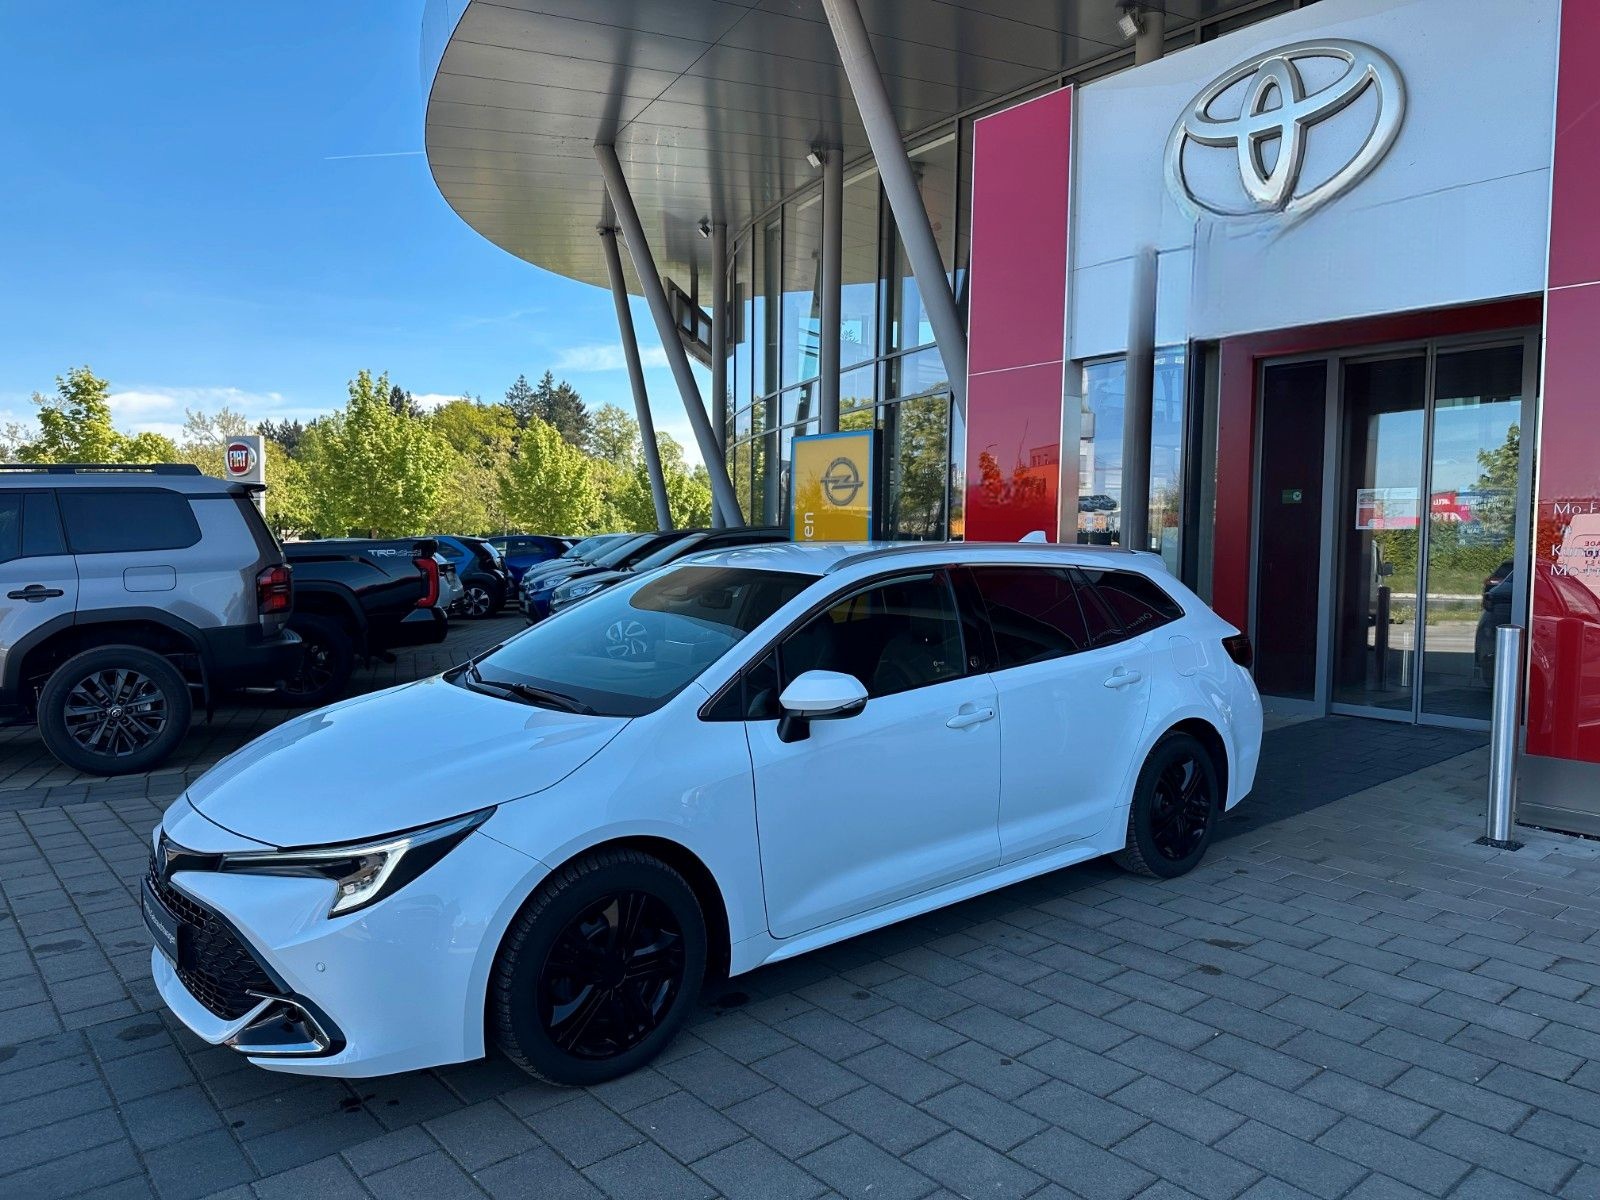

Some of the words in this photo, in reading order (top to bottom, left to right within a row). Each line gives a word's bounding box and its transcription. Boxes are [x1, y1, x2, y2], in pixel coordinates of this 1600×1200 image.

[229, 450, 247, 468] FIAT
[1553, 502, 1600, 514] Mo-F
[367, 549, 396, 557] TRD
